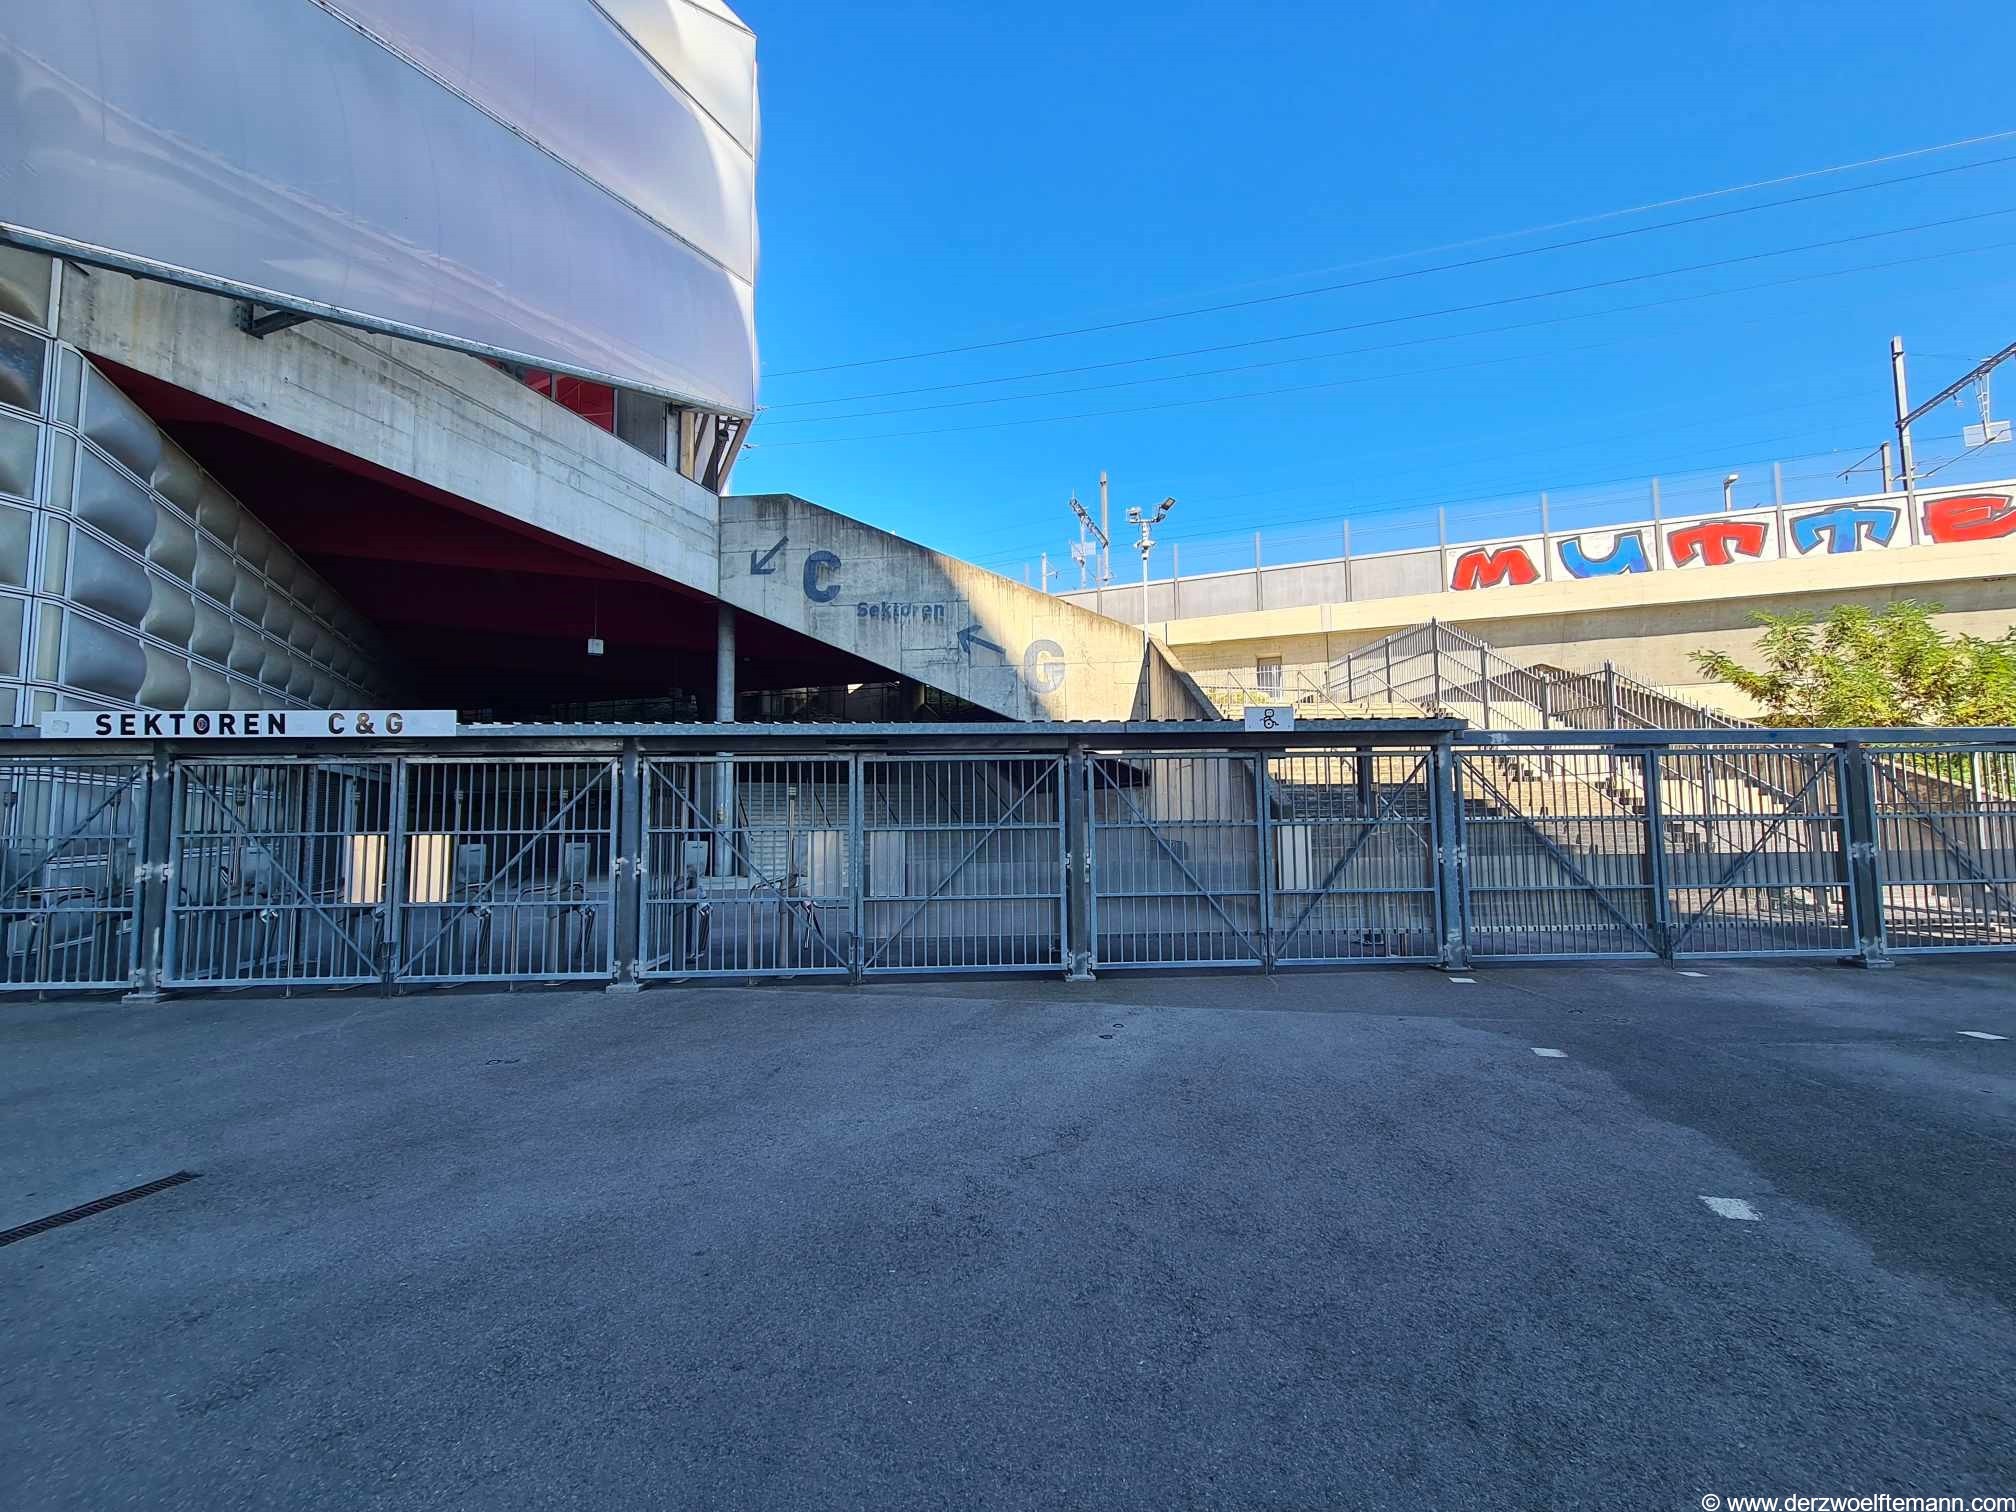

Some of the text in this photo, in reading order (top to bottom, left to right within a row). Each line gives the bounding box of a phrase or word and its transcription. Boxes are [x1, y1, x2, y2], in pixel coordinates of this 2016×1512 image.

[803, 550, 842, 603] C
[857, 601, 945, 619] Sektoren
[1023, 639, 1066, 693] G
[95, 713, 287, 736] SEKTOREN
